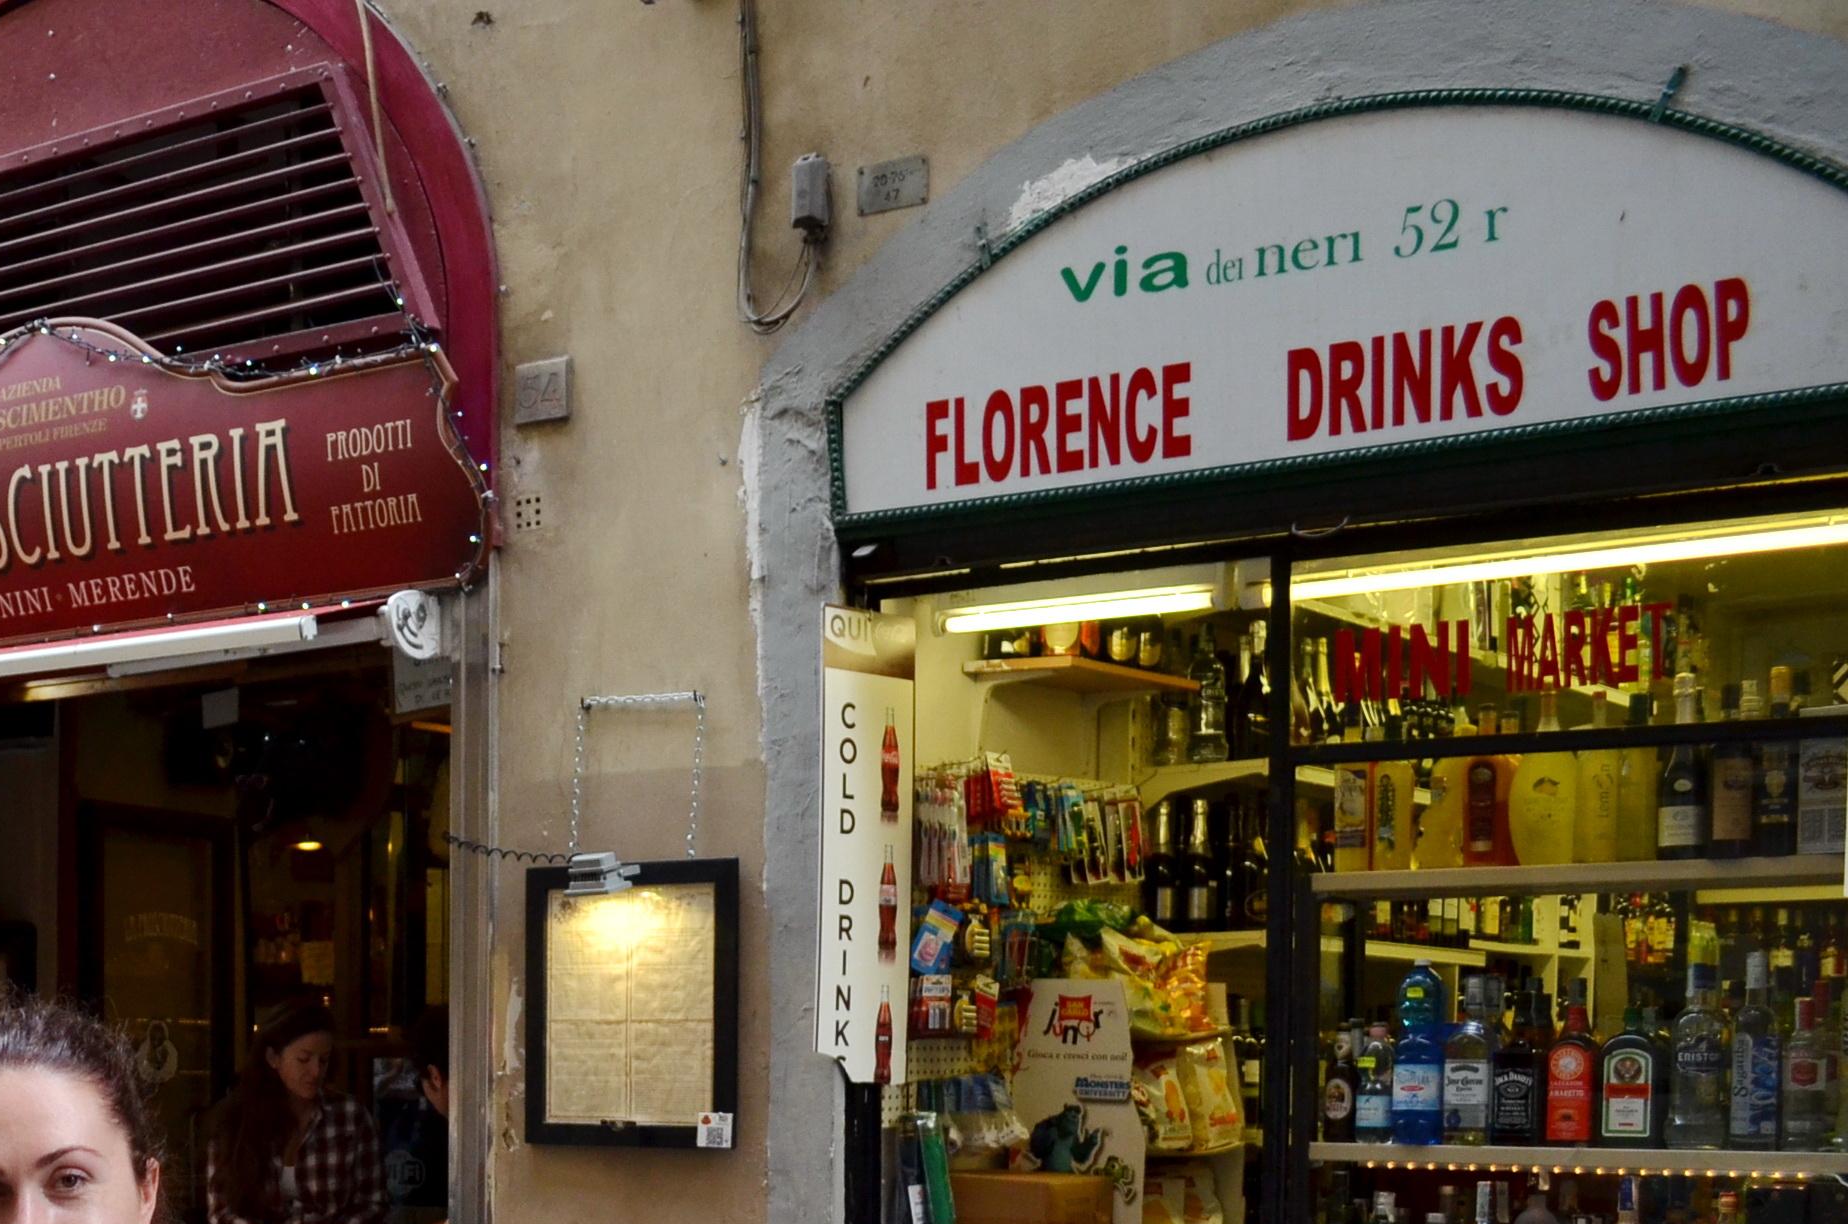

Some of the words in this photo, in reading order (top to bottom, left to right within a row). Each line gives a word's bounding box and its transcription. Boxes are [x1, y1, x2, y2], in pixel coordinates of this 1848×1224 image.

[1061, 245, 1190, 302] via
[1206, 248, 1244, 286] dei
[1255, 230, 1363, 278] neri
[1393, 198, 1461, 259] 52
[1484, 205, 1509, 243] r
[0, 376, 63, 403] AZIENDA
[926, 362, 1192, 490] FLORENCE
[1287, 315, 1524, 442] DRINKS
[1587, 277, 1751, 402] SHOP
[52, 417, 107, 442] FIRENZE
[326, 418, 413, 462] PRODOTTI
[361, 463, 381, 492] DI
[330, 493, 423, 535] FATTORIA
[67, 565, 197, 609] MERENDE
[1334, 619, 1471, 703] MINI
[1505, 601, 1674, 693] MARKET
[839, 702, 858, 835] COLD
